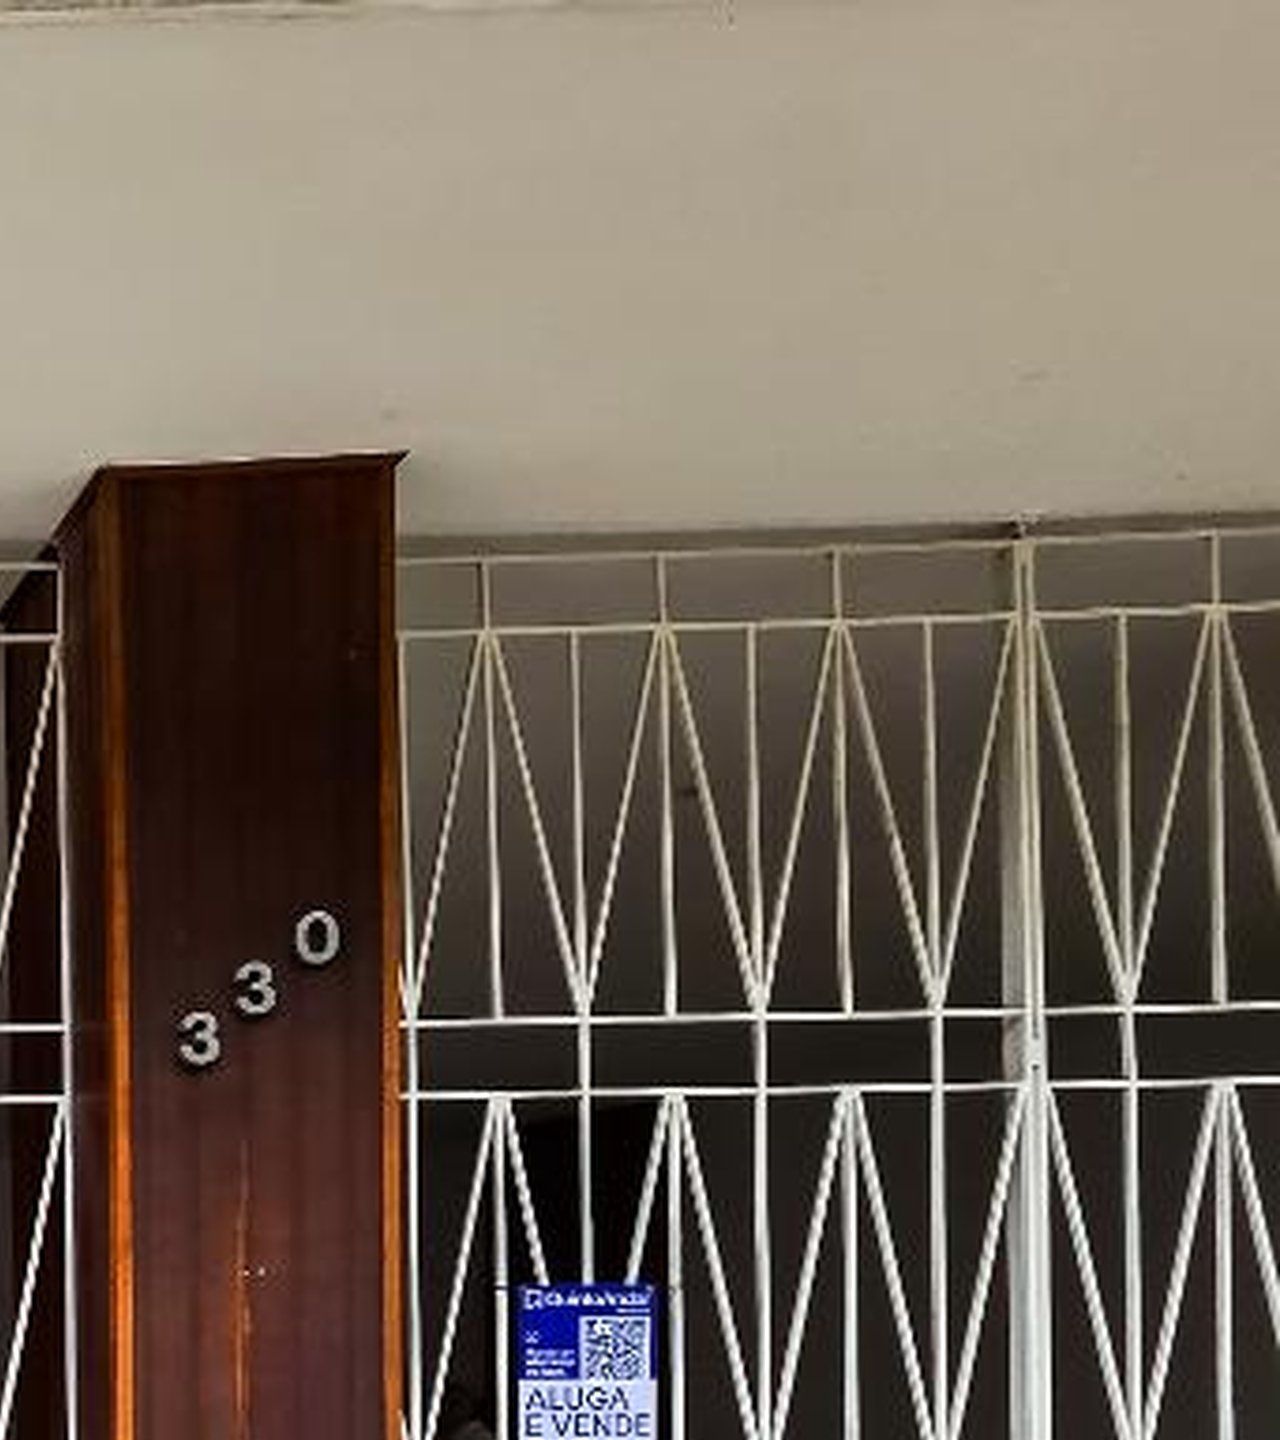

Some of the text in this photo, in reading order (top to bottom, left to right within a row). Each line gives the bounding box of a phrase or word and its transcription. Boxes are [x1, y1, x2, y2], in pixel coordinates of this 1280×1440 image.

[178, 910, 340, 1066] 330
[525, 1386, 629, 1411] ALUGA
[525, 1412, 651, 1437] E VENDE
